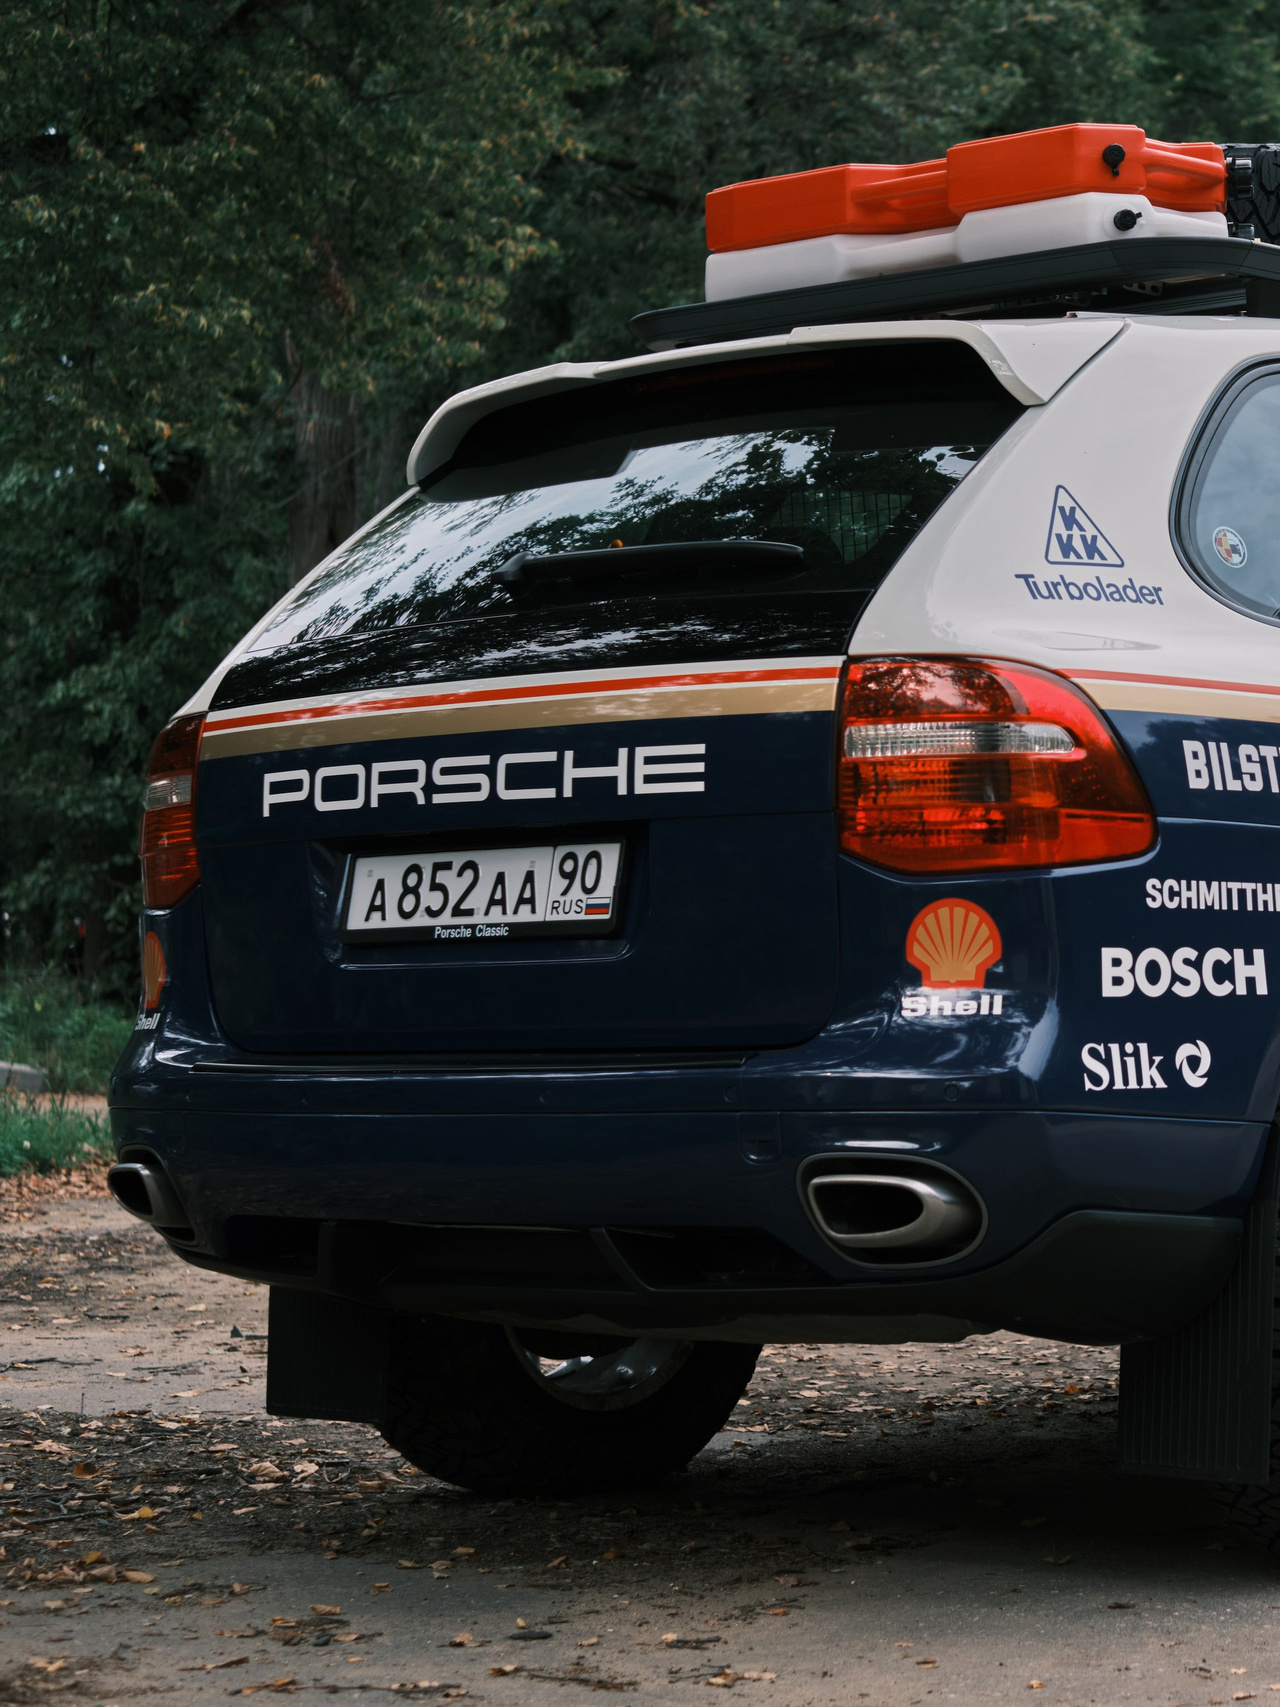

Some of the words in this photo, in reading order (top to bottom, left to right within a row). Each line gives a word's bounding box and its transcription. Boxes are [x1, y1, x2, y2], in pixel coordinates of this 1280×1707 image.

[1014, 573, 1165, 605] Turbolader
[262, 743, 706, 817] PORSCHE
[558, 850, 603, 897] 90
[550, 898, 584, 916] RUS
[434, 926, 472, 939] Porsche
[475, 924, 509, 937] Classic
[1101, 946, 1268, 998] BOSCH
[135, 1012, 161, 1031] Shell
[901, 994, 1003, 1017] Shell
[1081, 1041, 1168, 1092] Slik
